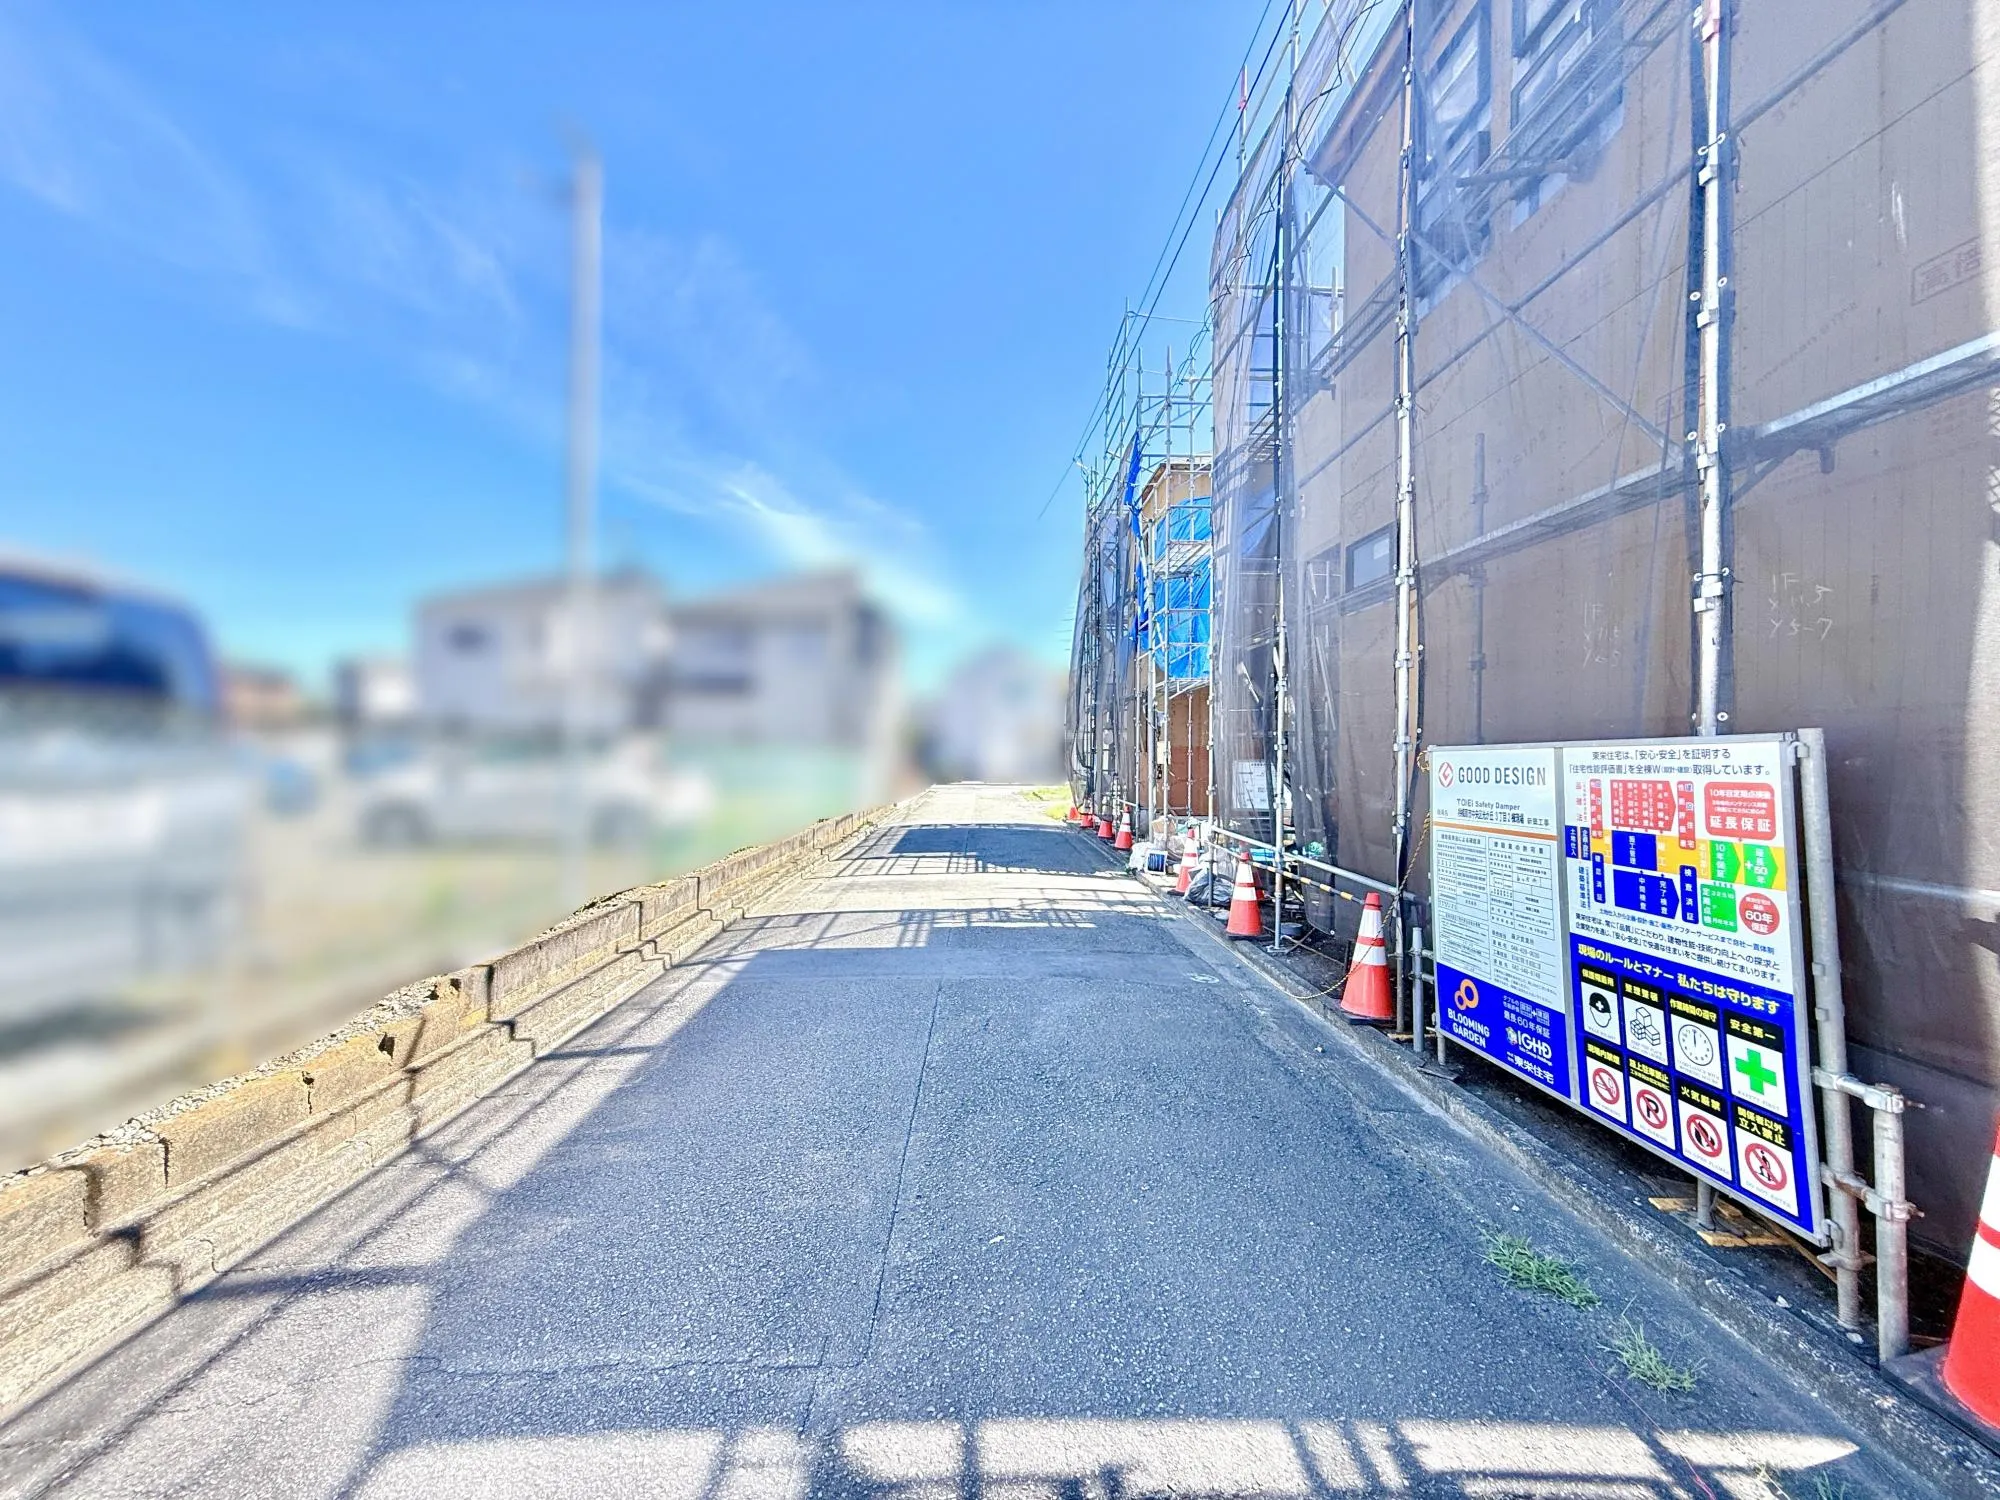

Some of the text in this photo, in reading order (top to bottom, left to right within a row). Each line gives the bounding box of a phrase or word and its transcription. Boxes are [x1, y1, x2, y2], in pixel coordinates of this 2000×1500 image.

[1458, 766, 1546, 786] GOOD DESIGN
[1475, 800, 1493, 810] Safety
[1495, 802, 1520, 812] Damper
[1745, 910, 1774, 925] 60年
[1578, 943, 1780, 1015] 現場のルールとマナー 私たちは守ります
[1447, 1007, 1490, 1038] BLOOMING
[1729, 1018, 1777, 1041] 安全第一
[1452, 1022, 1487, 1049] GARDEN
[1738, 1116, 1786, 1148] 立入禁止
